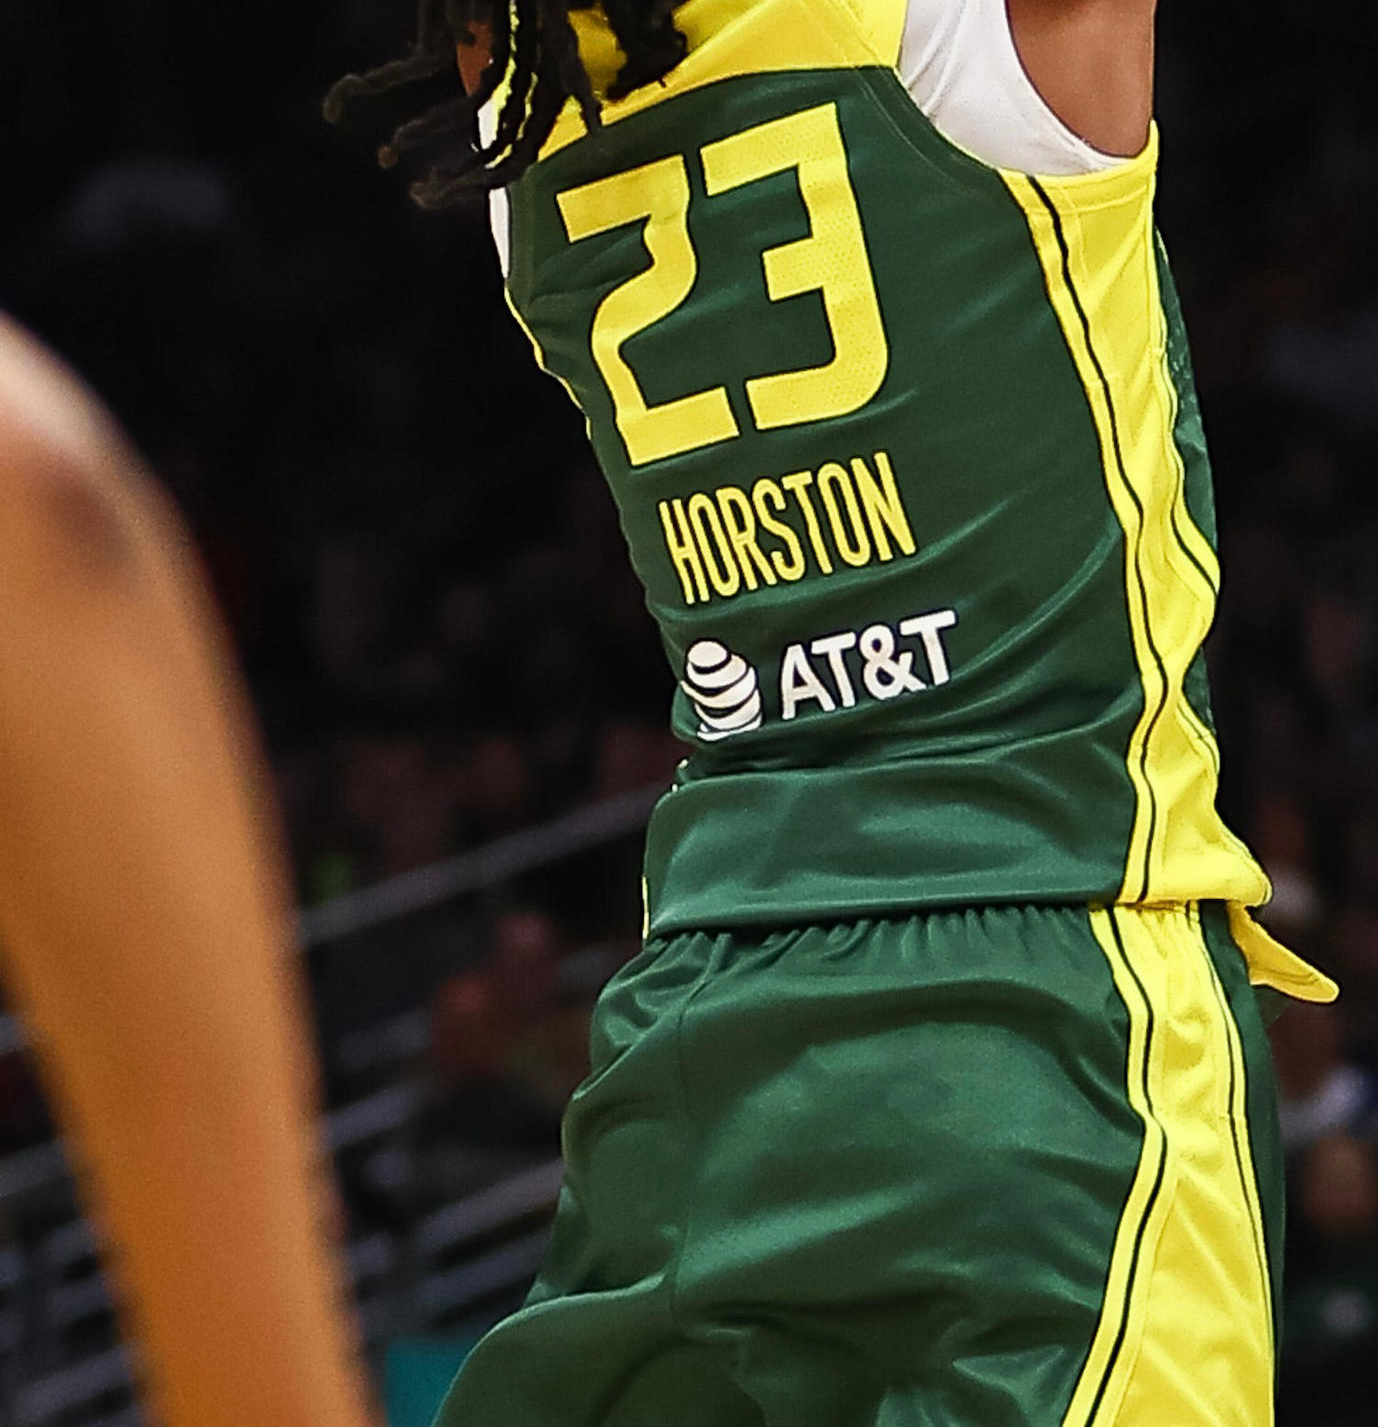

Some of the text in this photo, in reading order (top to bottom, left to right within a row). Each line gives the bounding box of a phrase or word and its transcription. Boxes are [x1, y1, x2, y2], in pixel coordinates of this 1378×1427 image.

[557, 101, 888, 466] 23
[658, 451, 916, 604] HORSTON
[780, 609, 957, 721] AT&T
